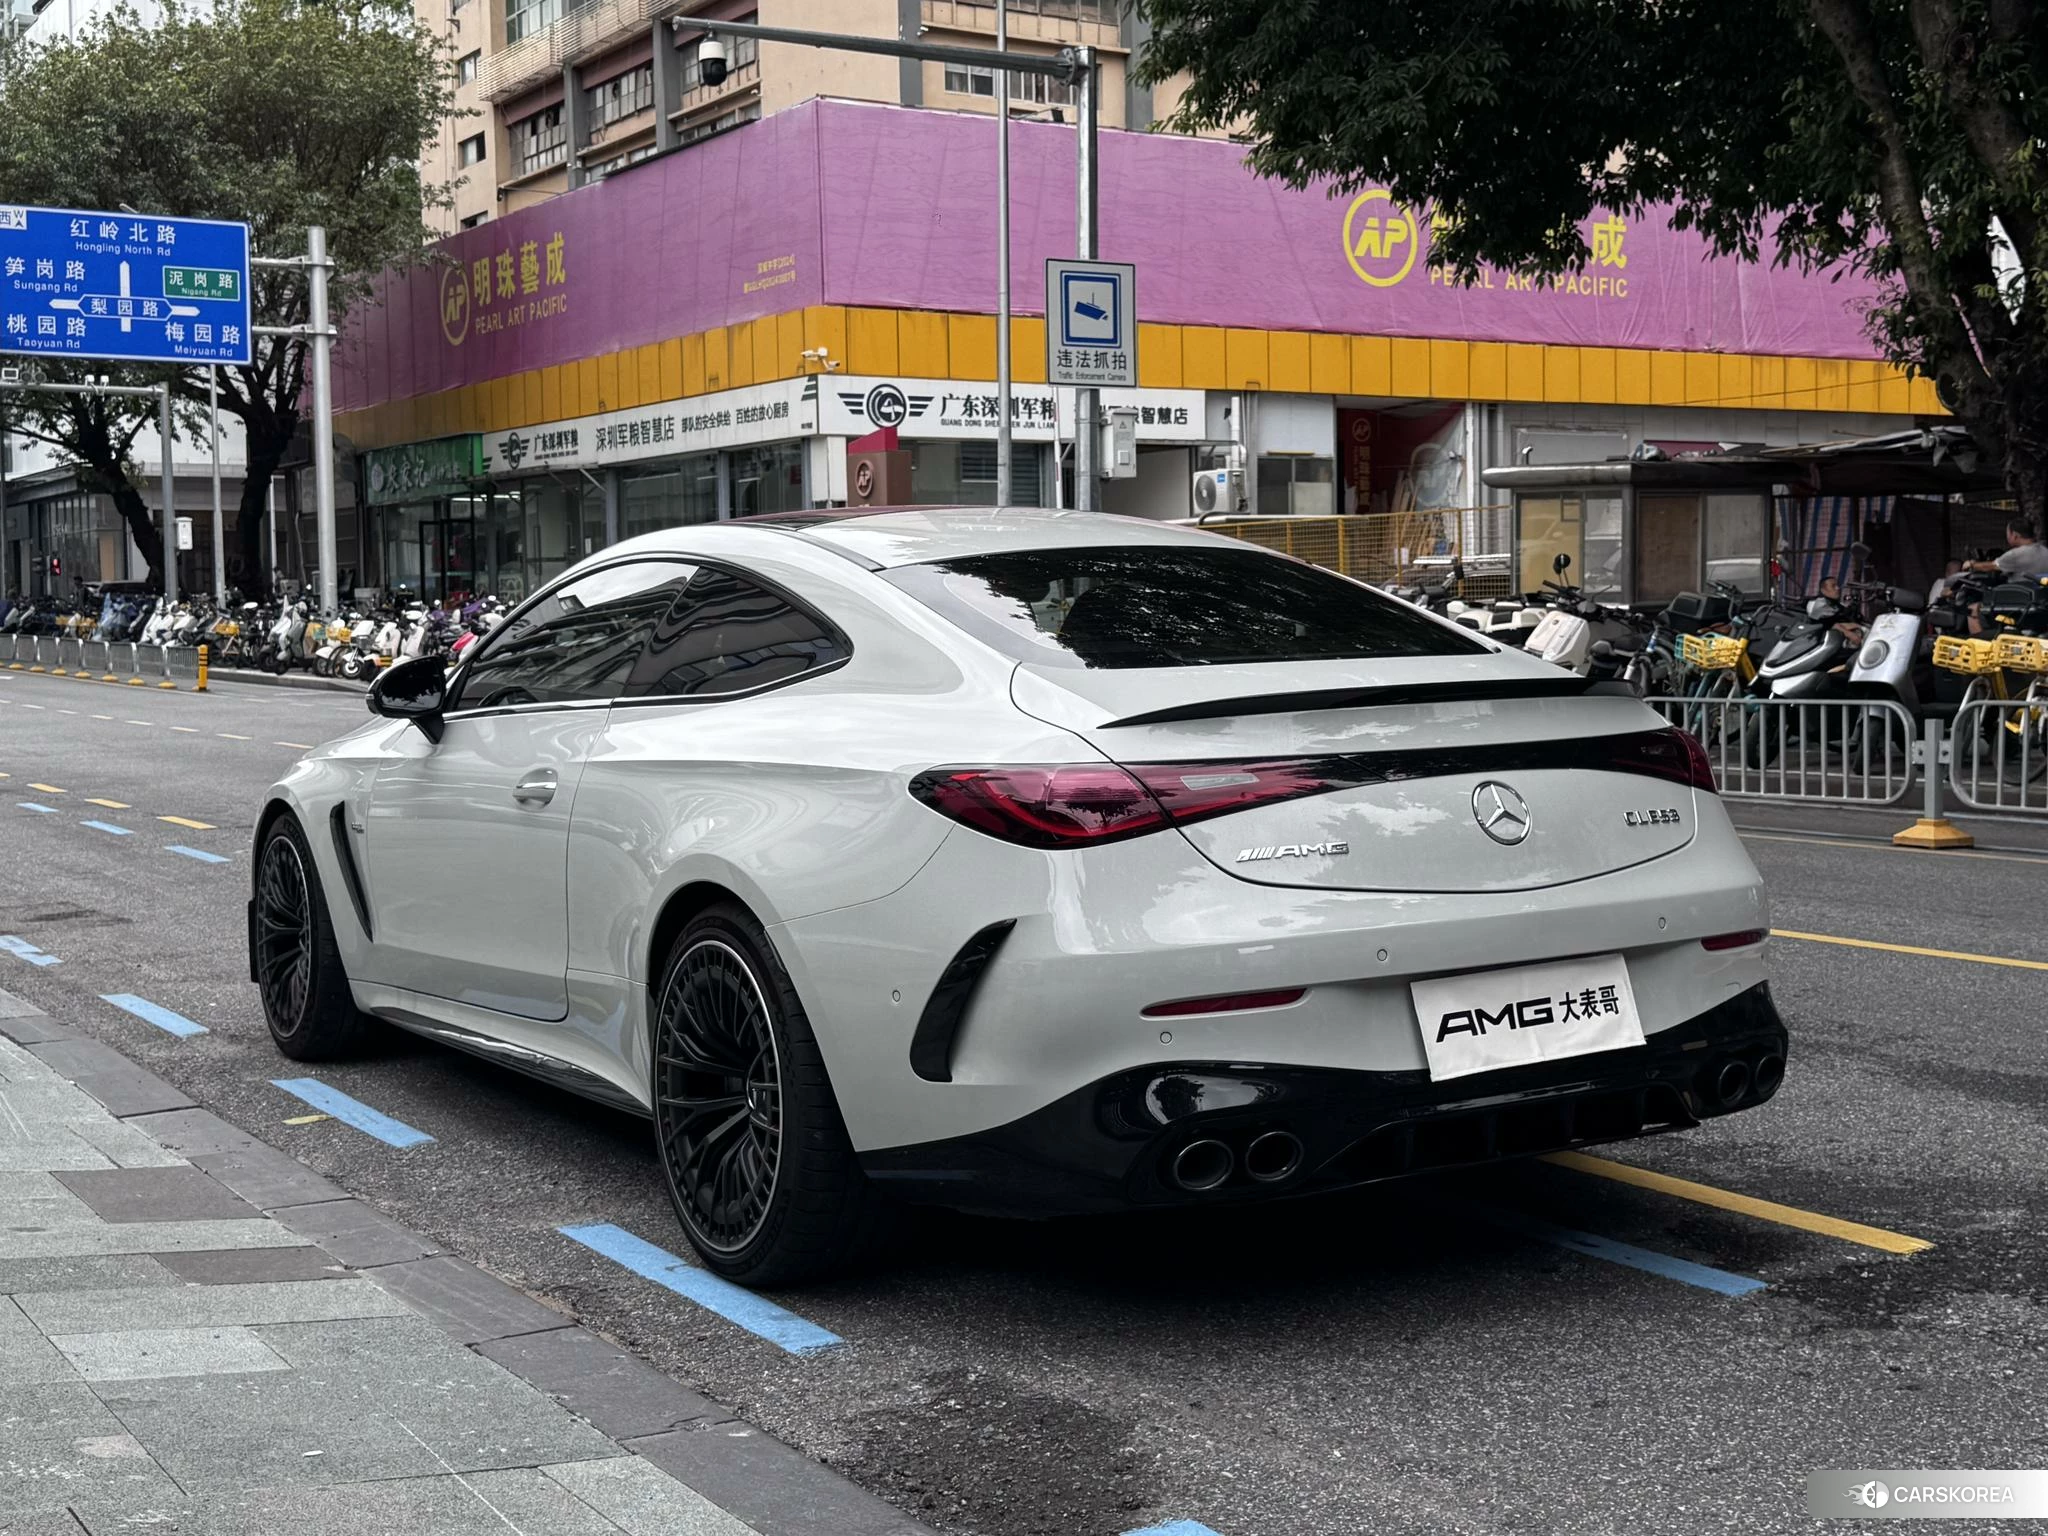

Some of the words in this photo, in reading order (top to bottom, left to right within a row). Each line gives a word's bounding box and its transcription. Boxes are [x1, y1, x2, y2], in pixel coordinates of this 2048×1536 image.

[70, 218, 177, 245] 红岭北路
[75, 241, 121, 255] Hongling
[124, 243, 152, 256] North
[157, 248, 171, 257] Rd
[5, 256, 86, 281] 笋岗路
[169, 270, 234, 289] 泥岗路
[473, 231, 566, 307] 明珠藝成
[14, 280, 60, 294] Sungang
[64, 282, 78, 292] Rd
[181, 287, 209, 298] Nigang
[211, 288, 222, 297] Rd
[1554, 275, 1628, 298] PACIFIC
[91, 298, 159, 317] 梨园路
[475, 312, 504, 335] PEARL
[508, 305, 525, 327] ART
[529, 293, 567, 321] PACIFIC
[6, 313, 87, 337] 桃园路
[165, 321, 241, 346] 梅园路
[17, 337, 63, 349] Taoyuan
[66, 339, 81, 349] Rd
[174, 345, 217, 357] Meiyuan
[219, 347, 233, 358] Rd
[1056, 349, 1127, 371] 违法抓拍
[941, 418, 963, 427] GUANG
[965, 419, 982, 427] DONG
[596, 416, 675, 452] 深圳军粮智慧店
[1623, 808, 1680, 827] CLE53
[1436, 997, 1554, 1043] AMG
[1559, 985, 1619, 1024] 大表哥
